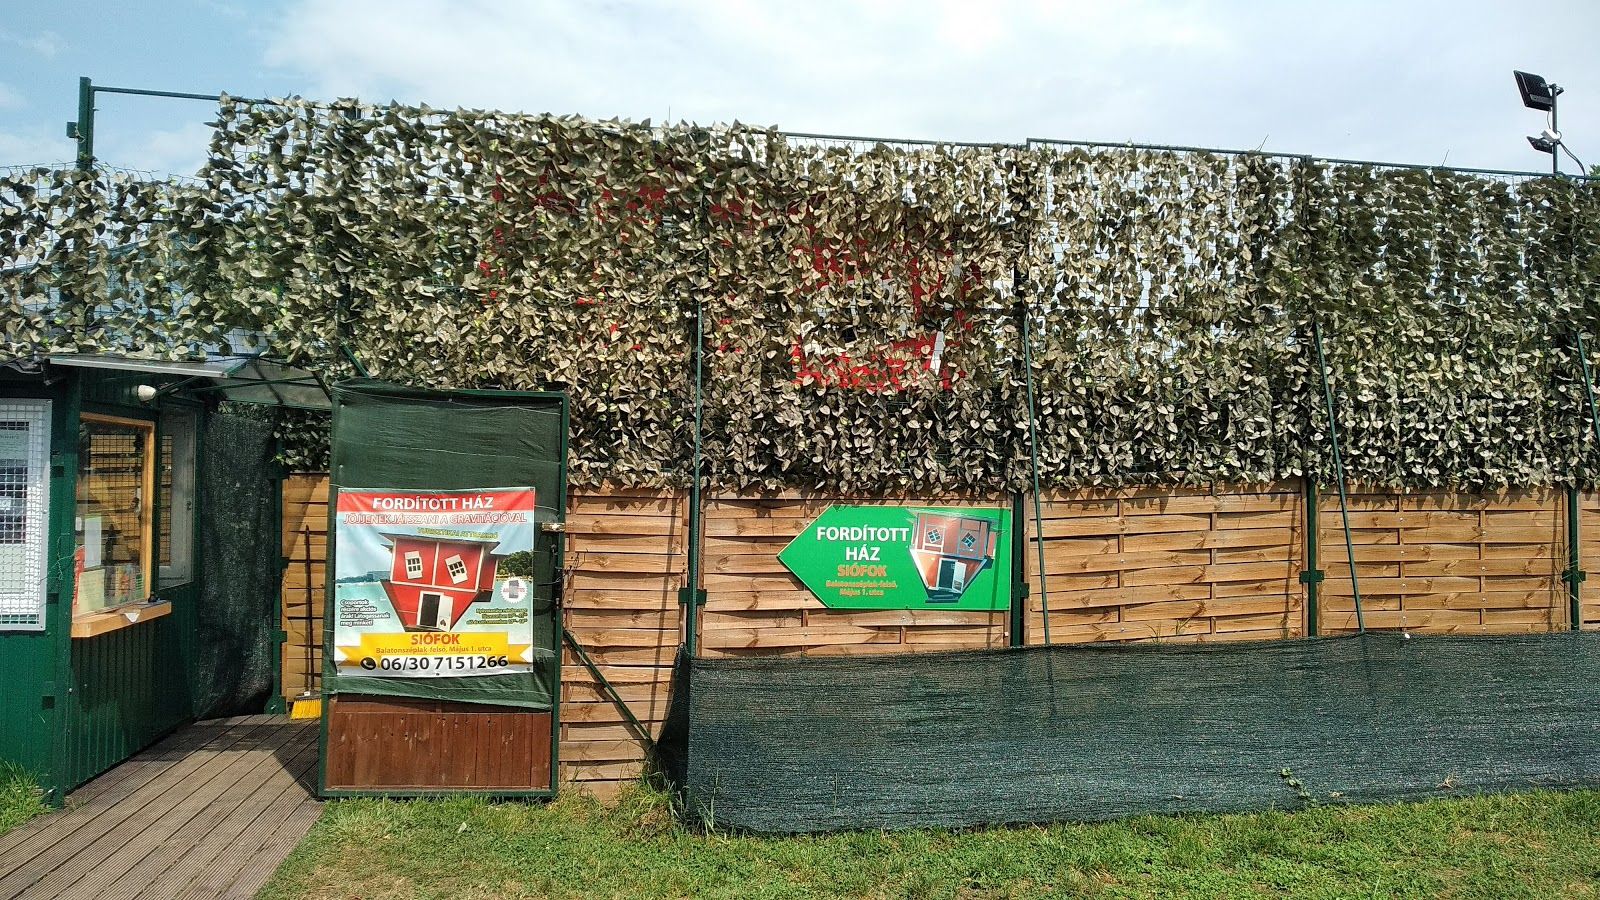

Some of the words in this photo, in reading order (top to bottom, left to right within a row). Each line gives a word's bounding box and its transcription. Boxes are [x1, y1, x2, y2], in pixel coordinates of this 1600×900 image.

[372, 496, 459, 510] FORDÍTOTT
[462, 495, 494, 509] HÁZ
[344, 513, 392, 525] JÖJJENEK
[391, 513, 439, 525] JÁTSZANI
[440, 515, 448, 524] A
[450, 511, 527, 524] GRAVITÁCIÓVAL
[816, 524, 910, 541] FORDÍTOTT
[845, 544, 880, 561] HÁZ
[837, 562, 887, 577] SIÓFOK
[411, 632, 460, 645] SIÓFOK
[376, 646, 427, 655] Balatonszéplak
[449, 645, 469, 653] Május
[380, 657, 430, 671] 06/30
[434, 656, 508, 670] 7151266
